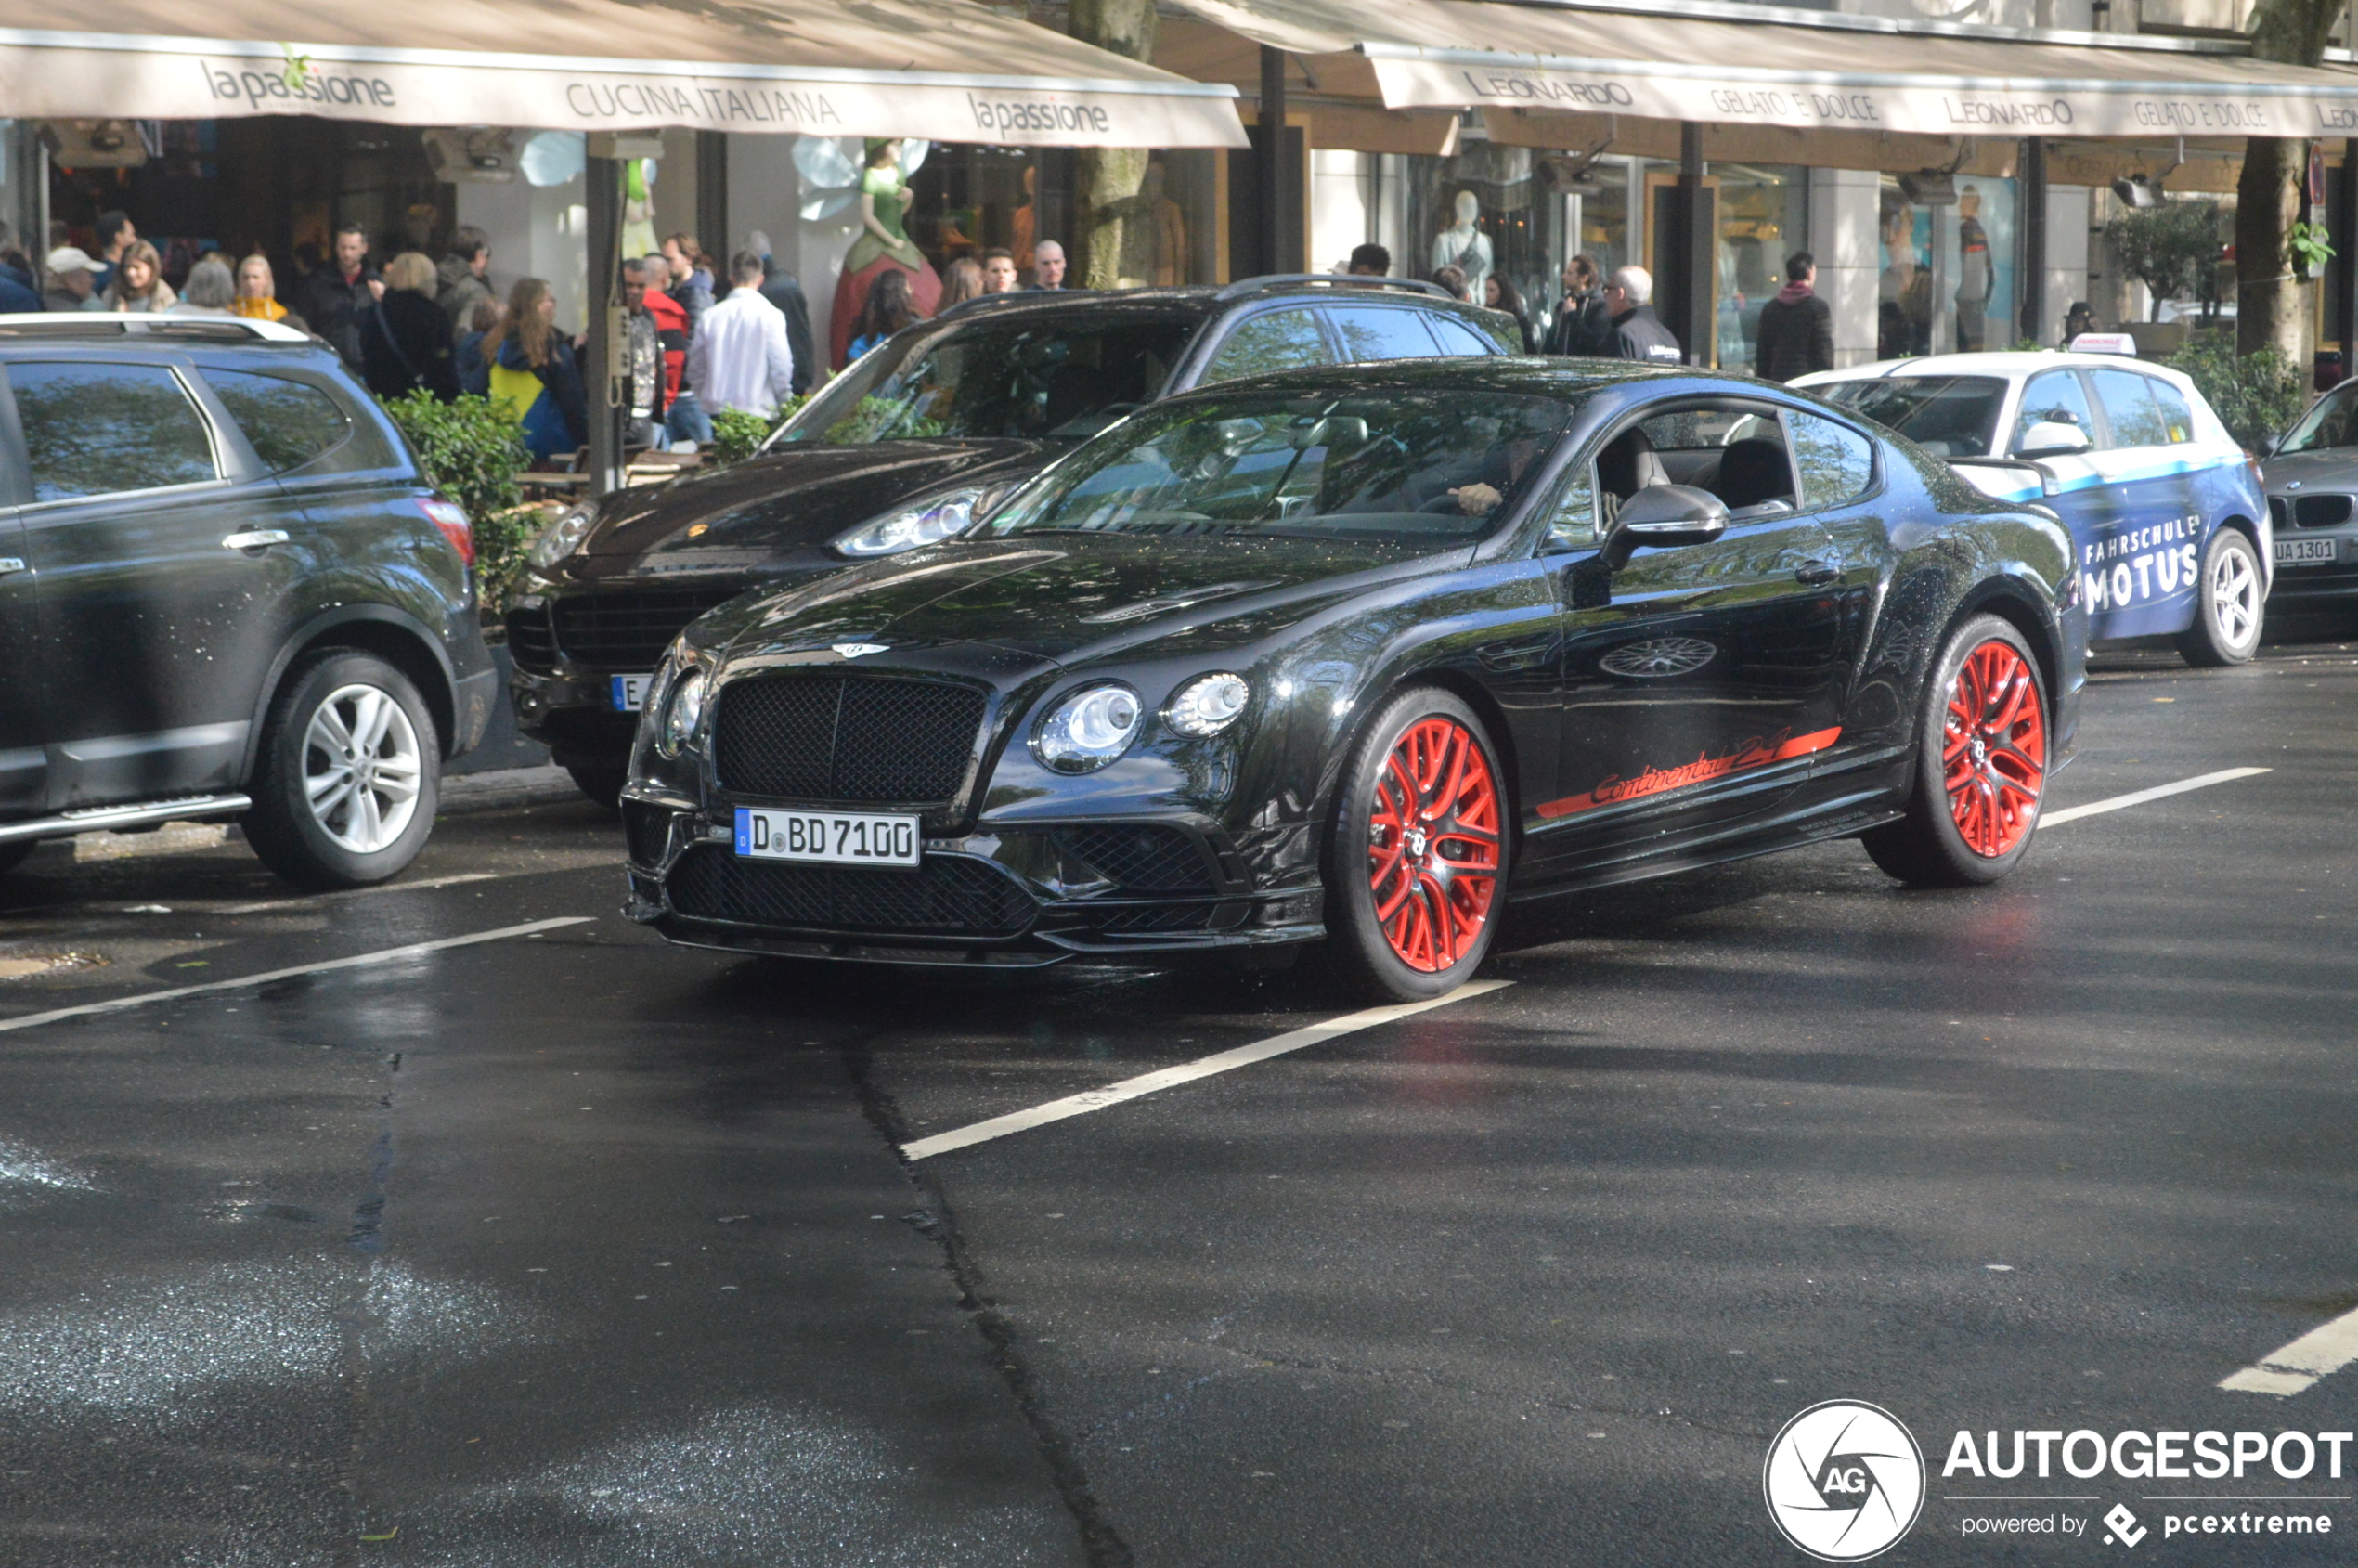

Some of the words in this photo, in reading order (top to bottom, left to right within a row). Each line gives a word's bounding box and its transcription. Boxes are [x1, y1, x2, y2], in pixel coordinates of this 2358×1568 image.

[566, 83, 700, 118] CUCINA
[697, 88, 842, 124] ITALIANA
[1462, 71, 1633, 107] LEONARDO
[1711, 89, 1787, 116] GELATO
[1792, 93, 1809, 117] E
[1811, 94, 1879, 121] DOLCE
[1943, 97, 2073, 125] LEONARDO
[2135, 101, 2195, 126] GELATO
[2199, 103, 2212, 126] E
[2214, 104, 2267, 127] DOLCE
[2274, 544, 2293, 560] UA
[2297, 541, 2333, 559] 1301
[2085, 543, 2197, 615] MOTUS
[626, 680, 640, 706] E
[1590, 745, 1727, 804] Continental
[753, 815, 769, 850] D
[789, 817, 825, 854] BD
[834, 820, 913, 858] 7100
